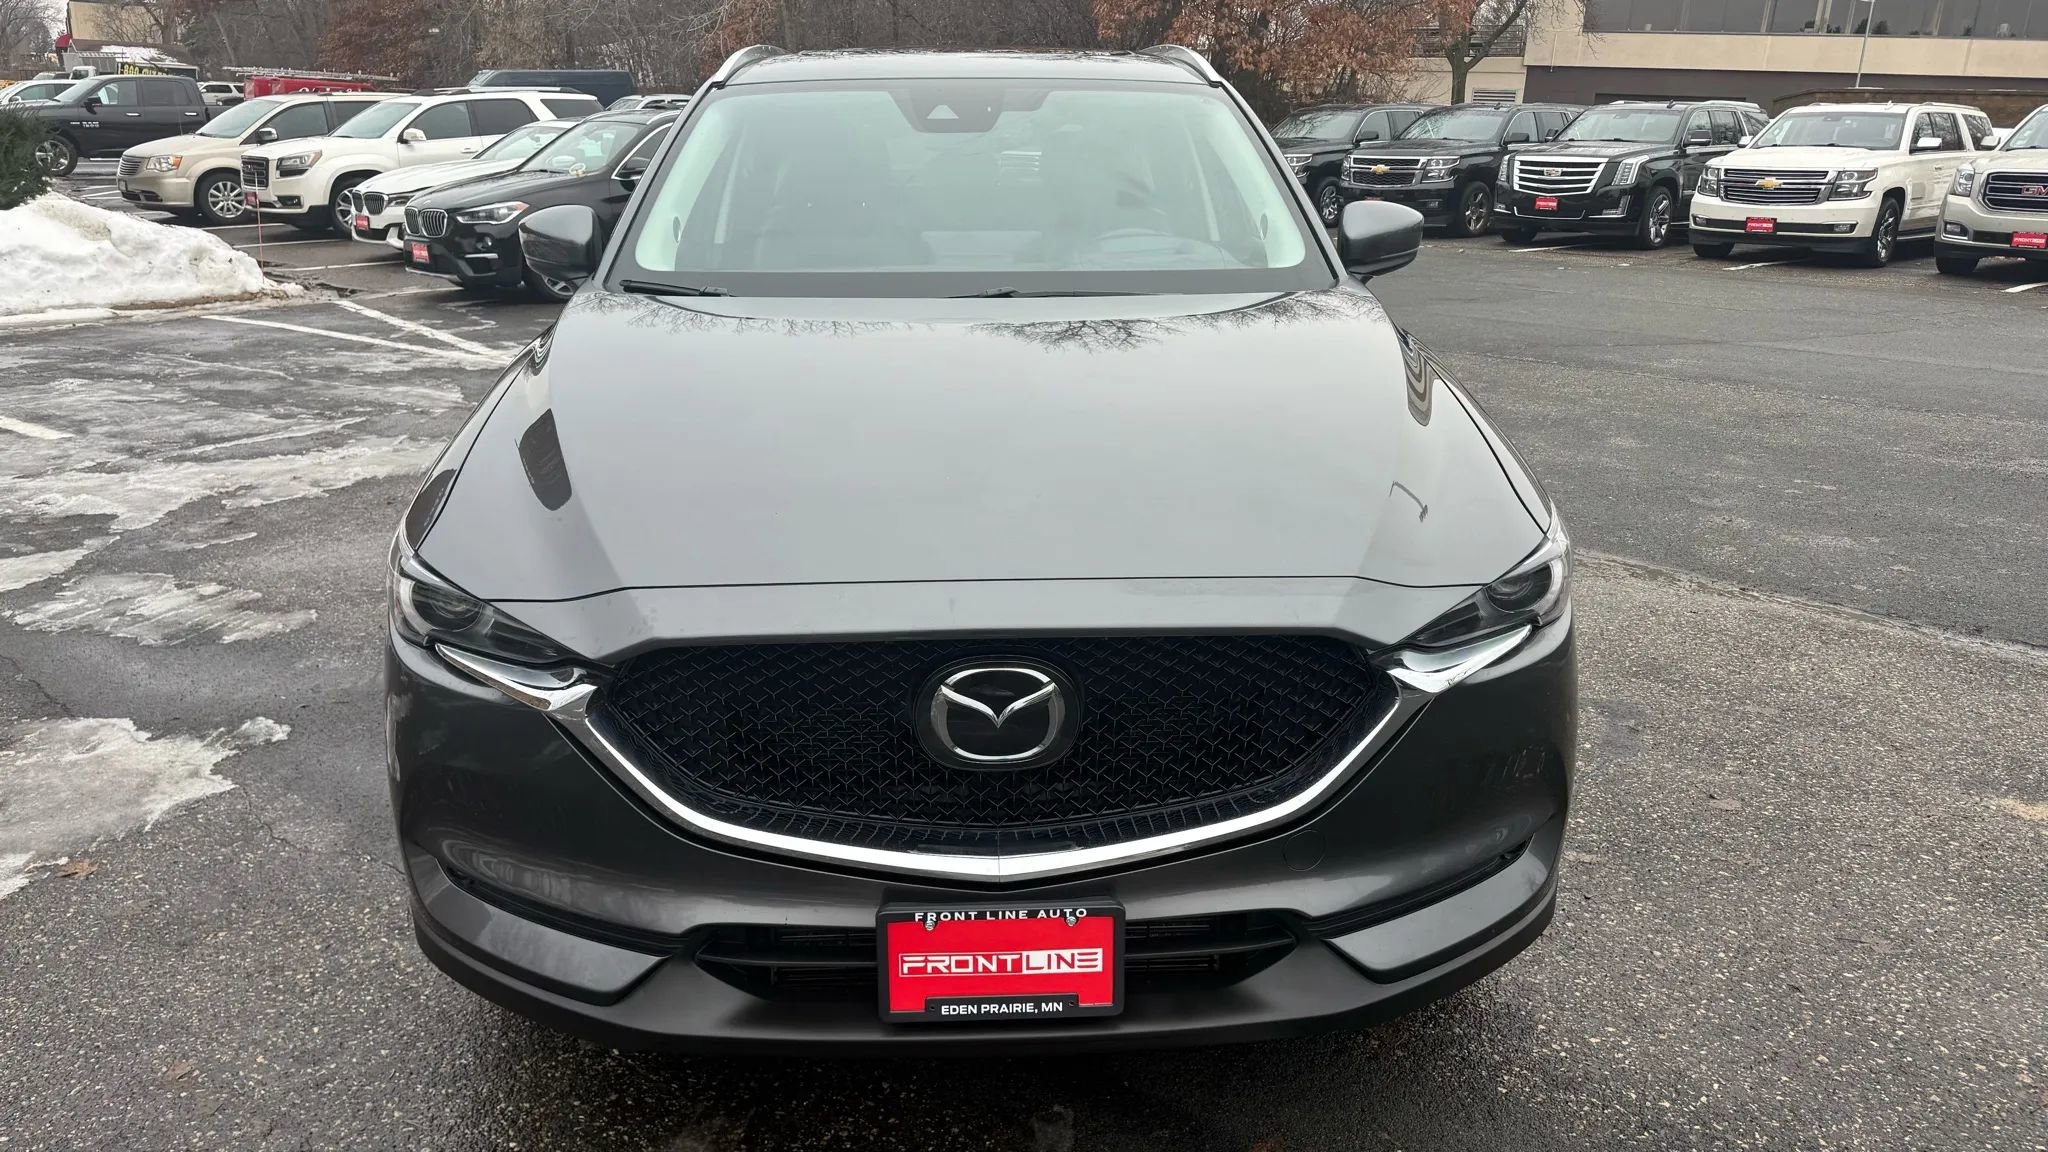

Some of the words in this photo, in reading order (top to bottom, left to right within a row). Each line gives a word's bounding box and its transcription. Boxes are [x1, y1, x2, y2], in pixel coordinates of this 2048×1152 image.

[914, 911, 978, 923] FRONT
[986, 910, 1029, 921] LINE
[1037, 908, 1088, 920] AUTO
[902, 951, 1100, 974] FRONTLINE
[941, 1004, 978, 1015] EDEN
[981, 1002, 1039, 1015] PRAIRIE,
[1041, 1001, 1063, 1013] MN
